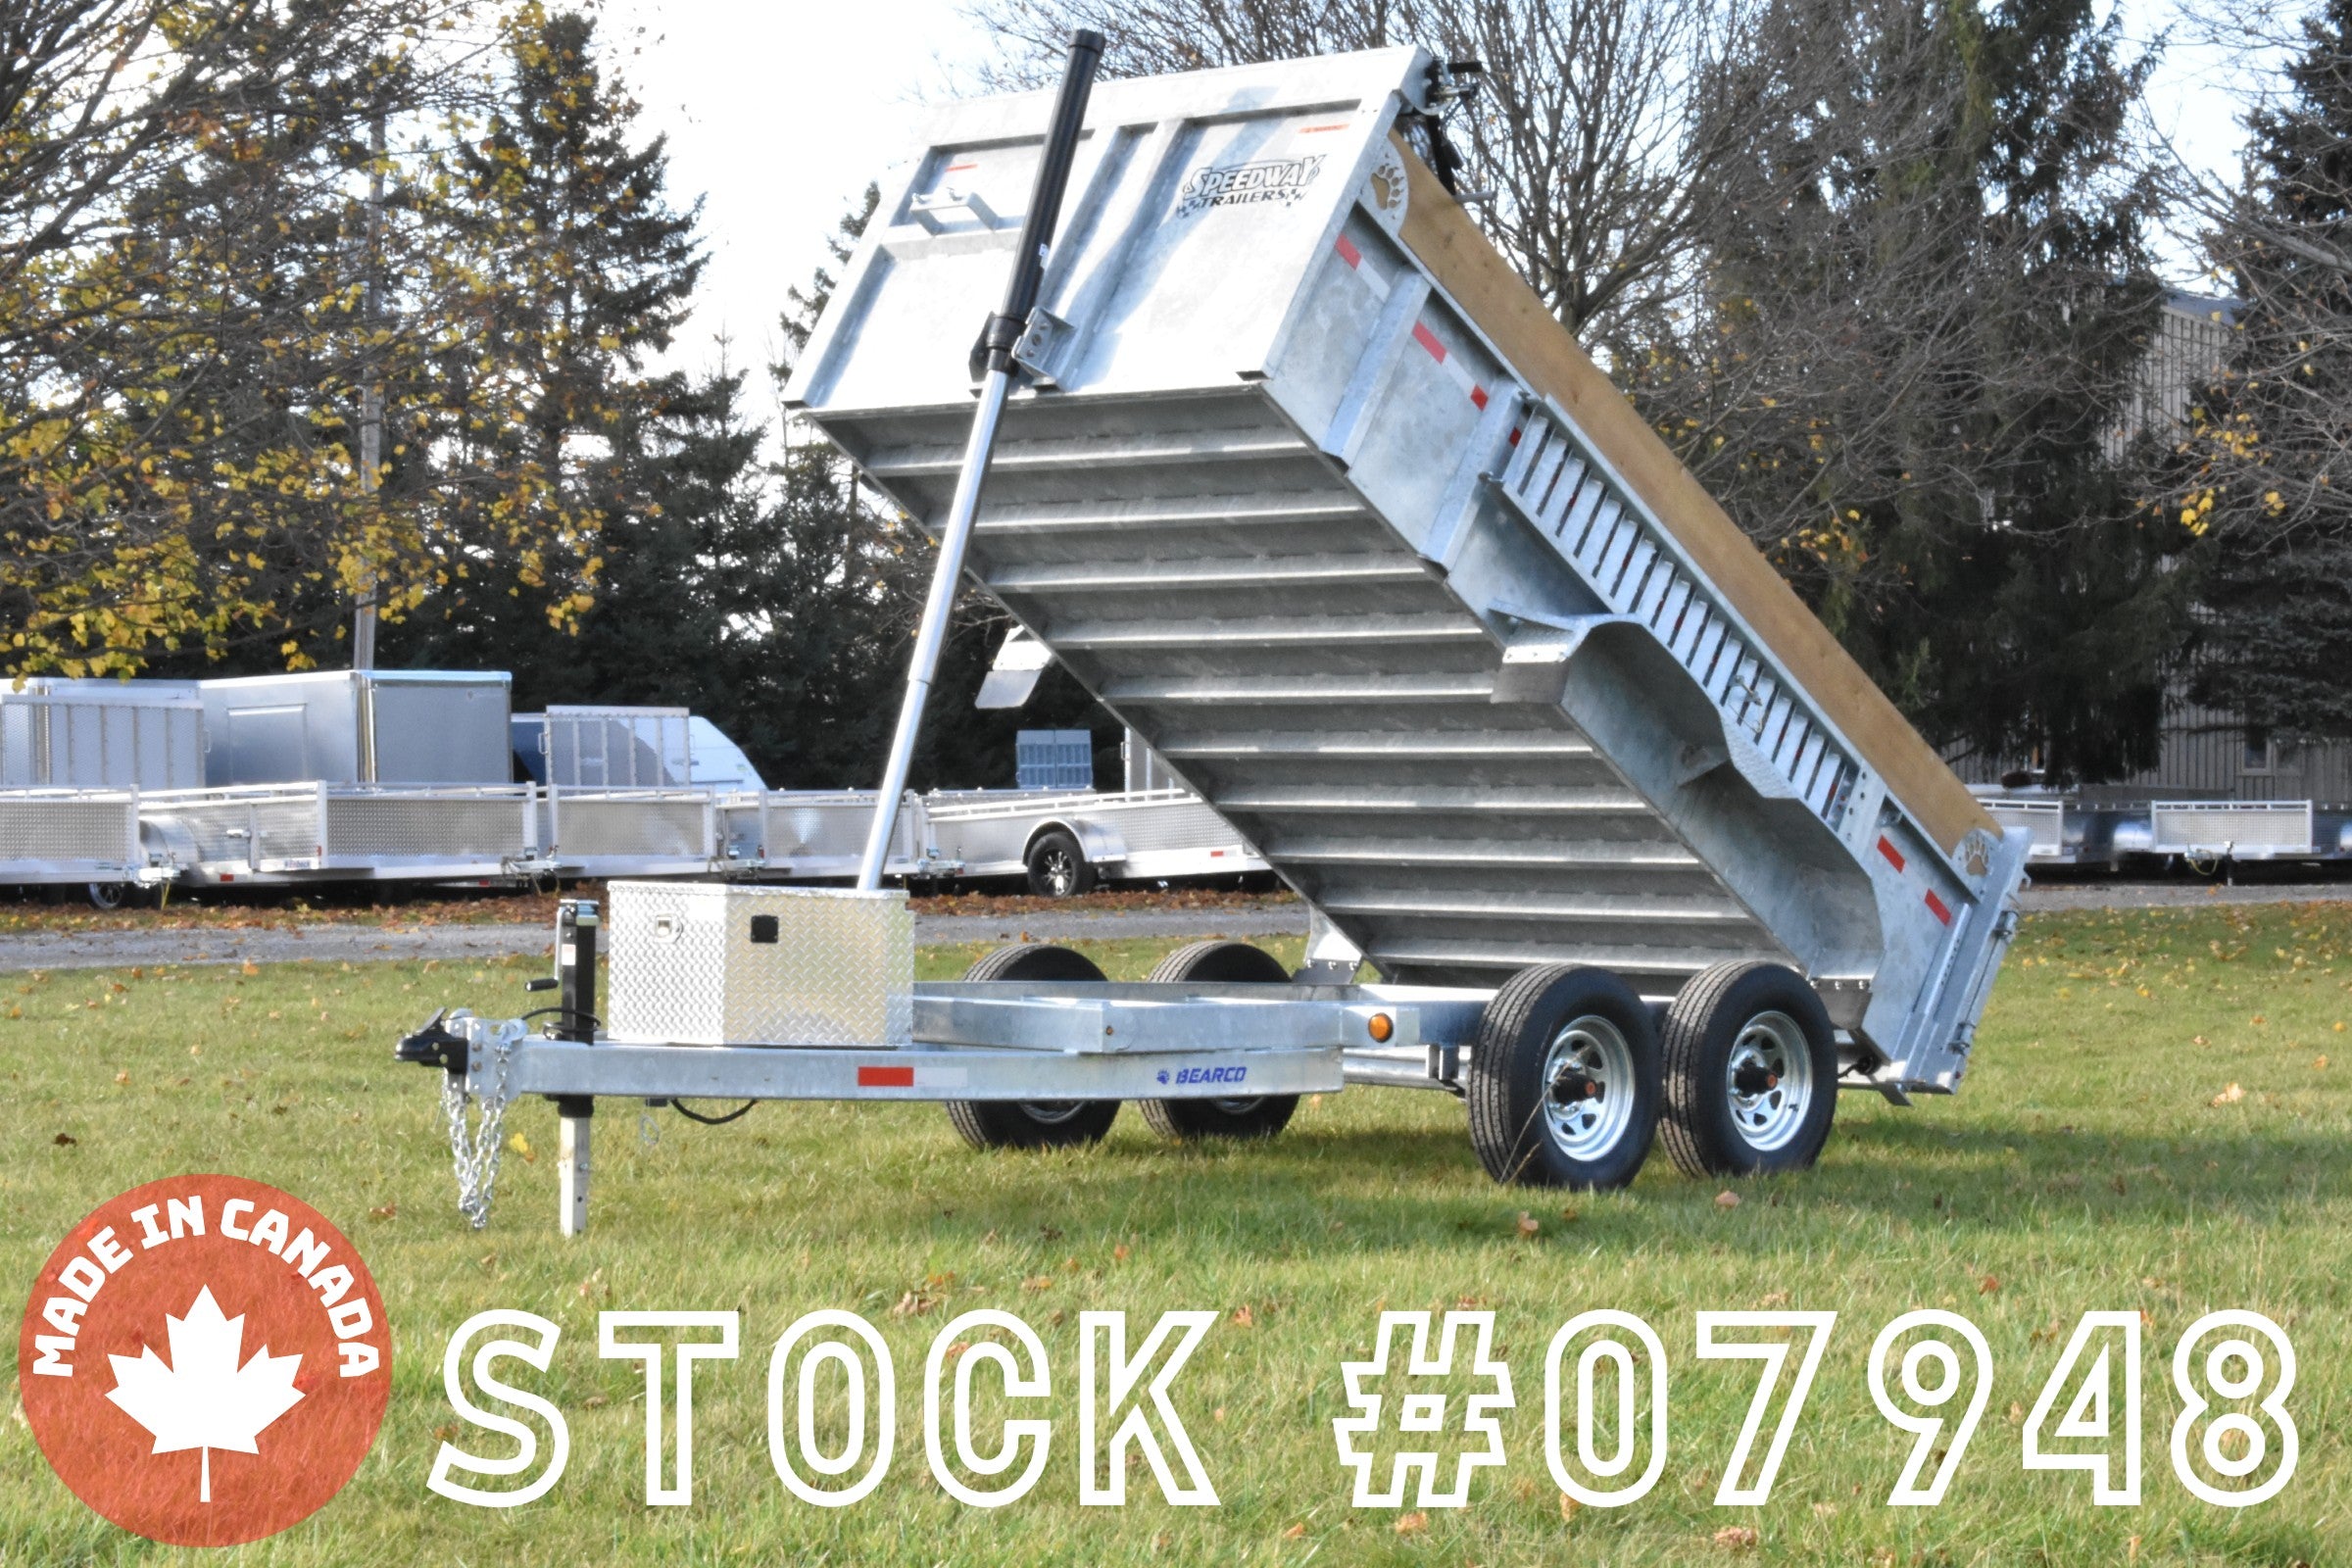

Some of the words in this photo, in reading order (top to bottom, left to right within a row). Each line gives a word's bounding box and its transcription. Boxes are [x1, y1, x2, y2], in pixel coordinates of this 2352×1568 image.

[1184, 155, 1326, 199] SPEEDWAY
[1201, 188, 1285, 207] TRAILERS
[1176, 1067, 1247, 1084] BEARCO
